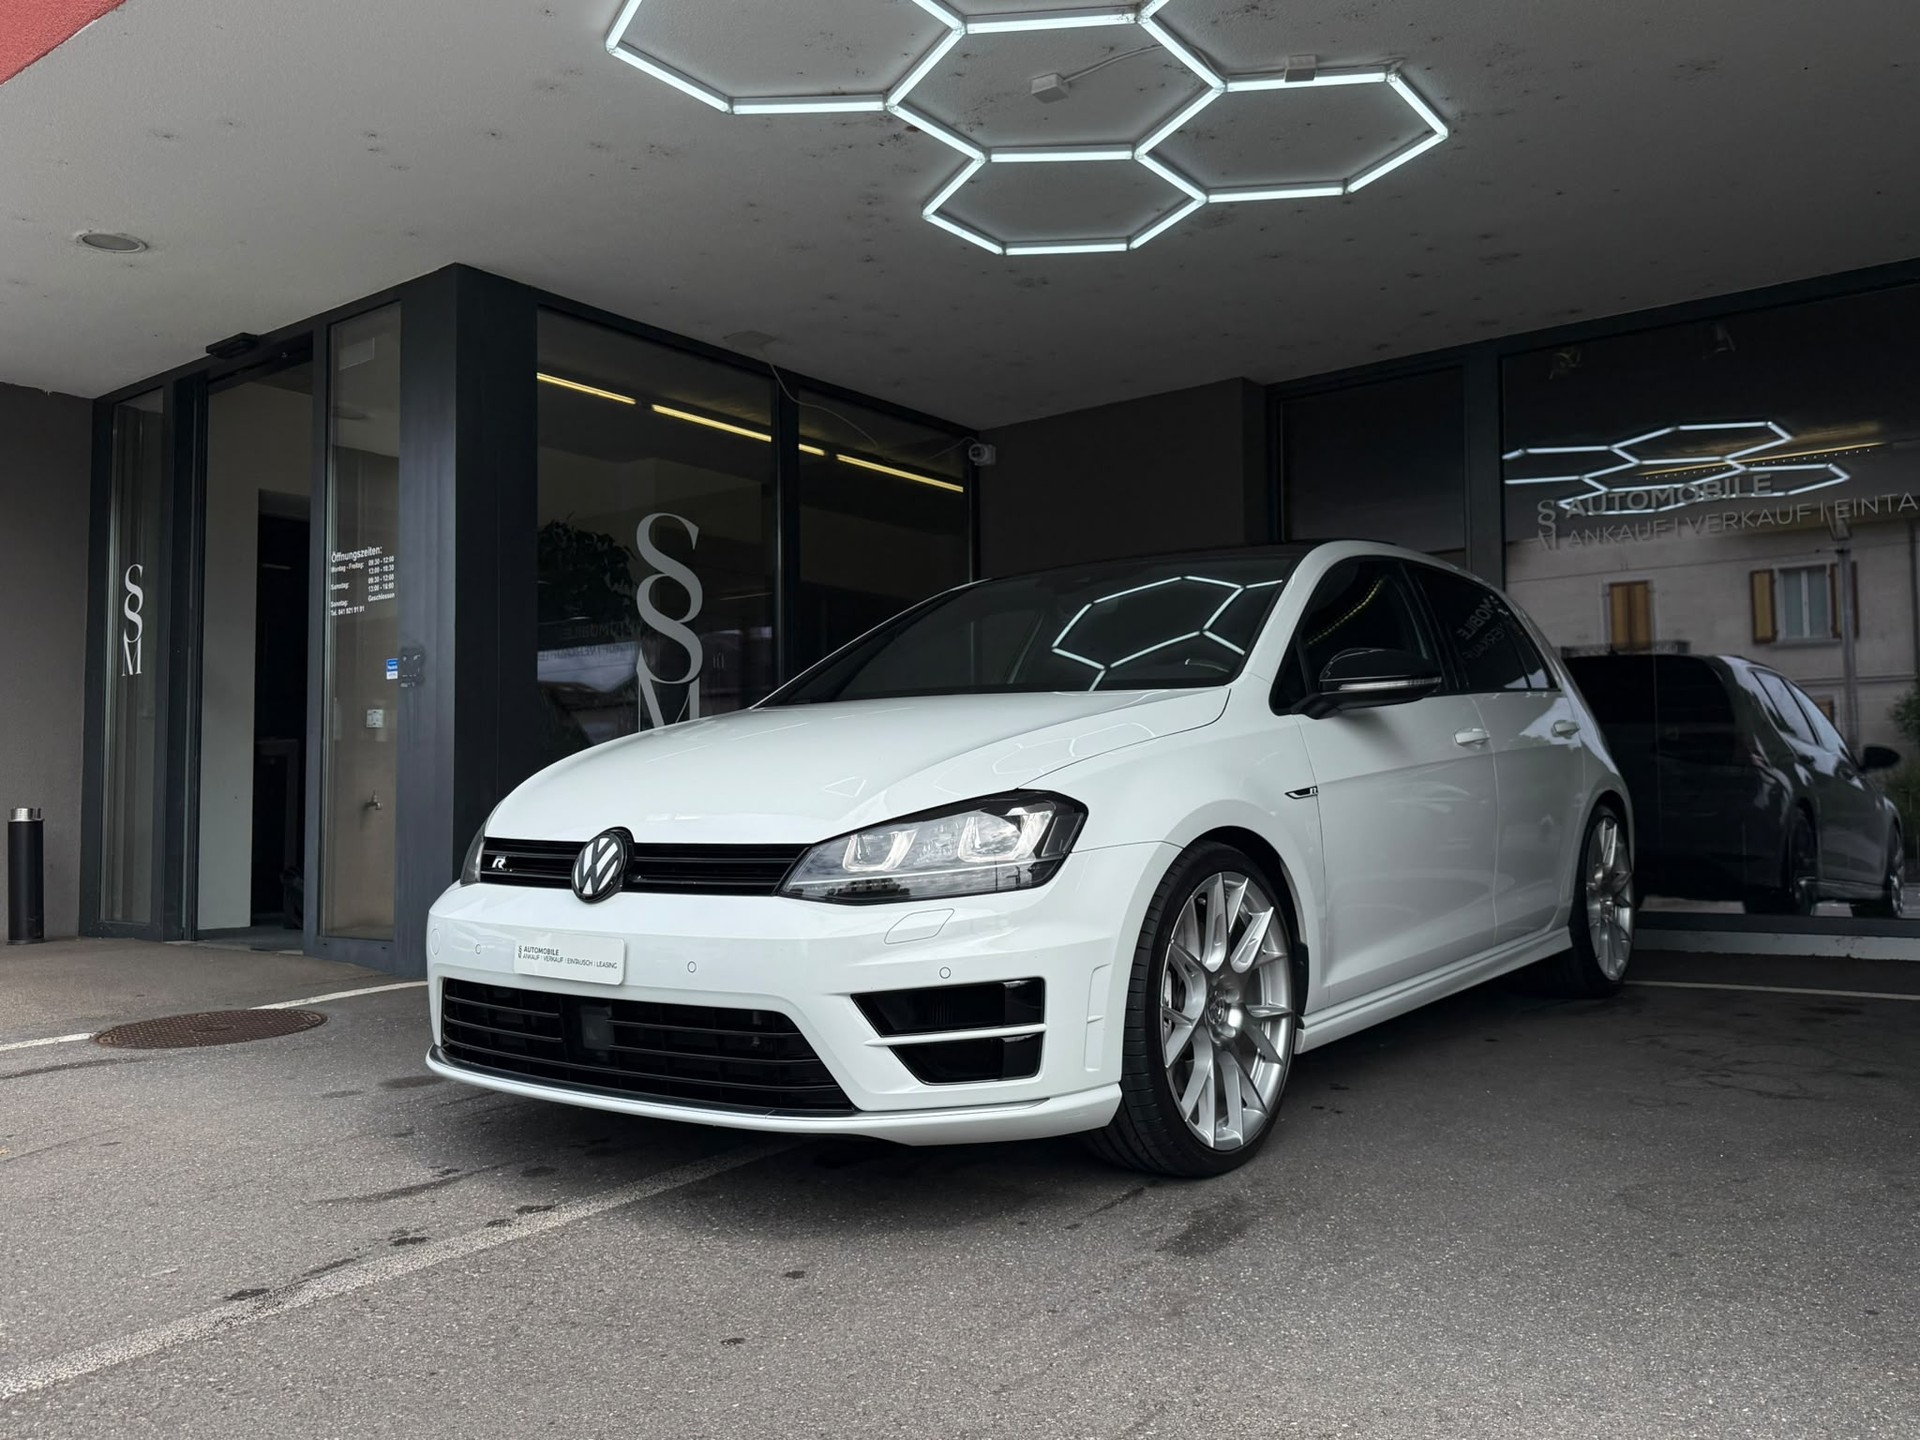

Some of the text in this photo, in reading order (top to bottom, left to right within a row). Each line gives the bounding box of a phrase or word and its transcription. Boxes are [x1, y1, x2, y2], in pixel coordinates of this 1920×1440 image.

[1566, 474, 1772, 517] AUTOMOBILE
[1568, 519, 1667, 549] ANKAUF
[1684, 503, 1813, 536] VERKAUF
[1834, 492, 1919, 519] EINTA
[331, 546, 383, 563] Öffnungszeiten:
[491, 855, 507, 871] R
[523, 945, 560, 956] AUTOMOBILE
[522, 953, 540, 961] ANKAUF
[543, 955, 564, 964] VERKAUF
[567, 957, 593, 967] EINTAUSCH
[596, 960, 618, 969] LEASING
